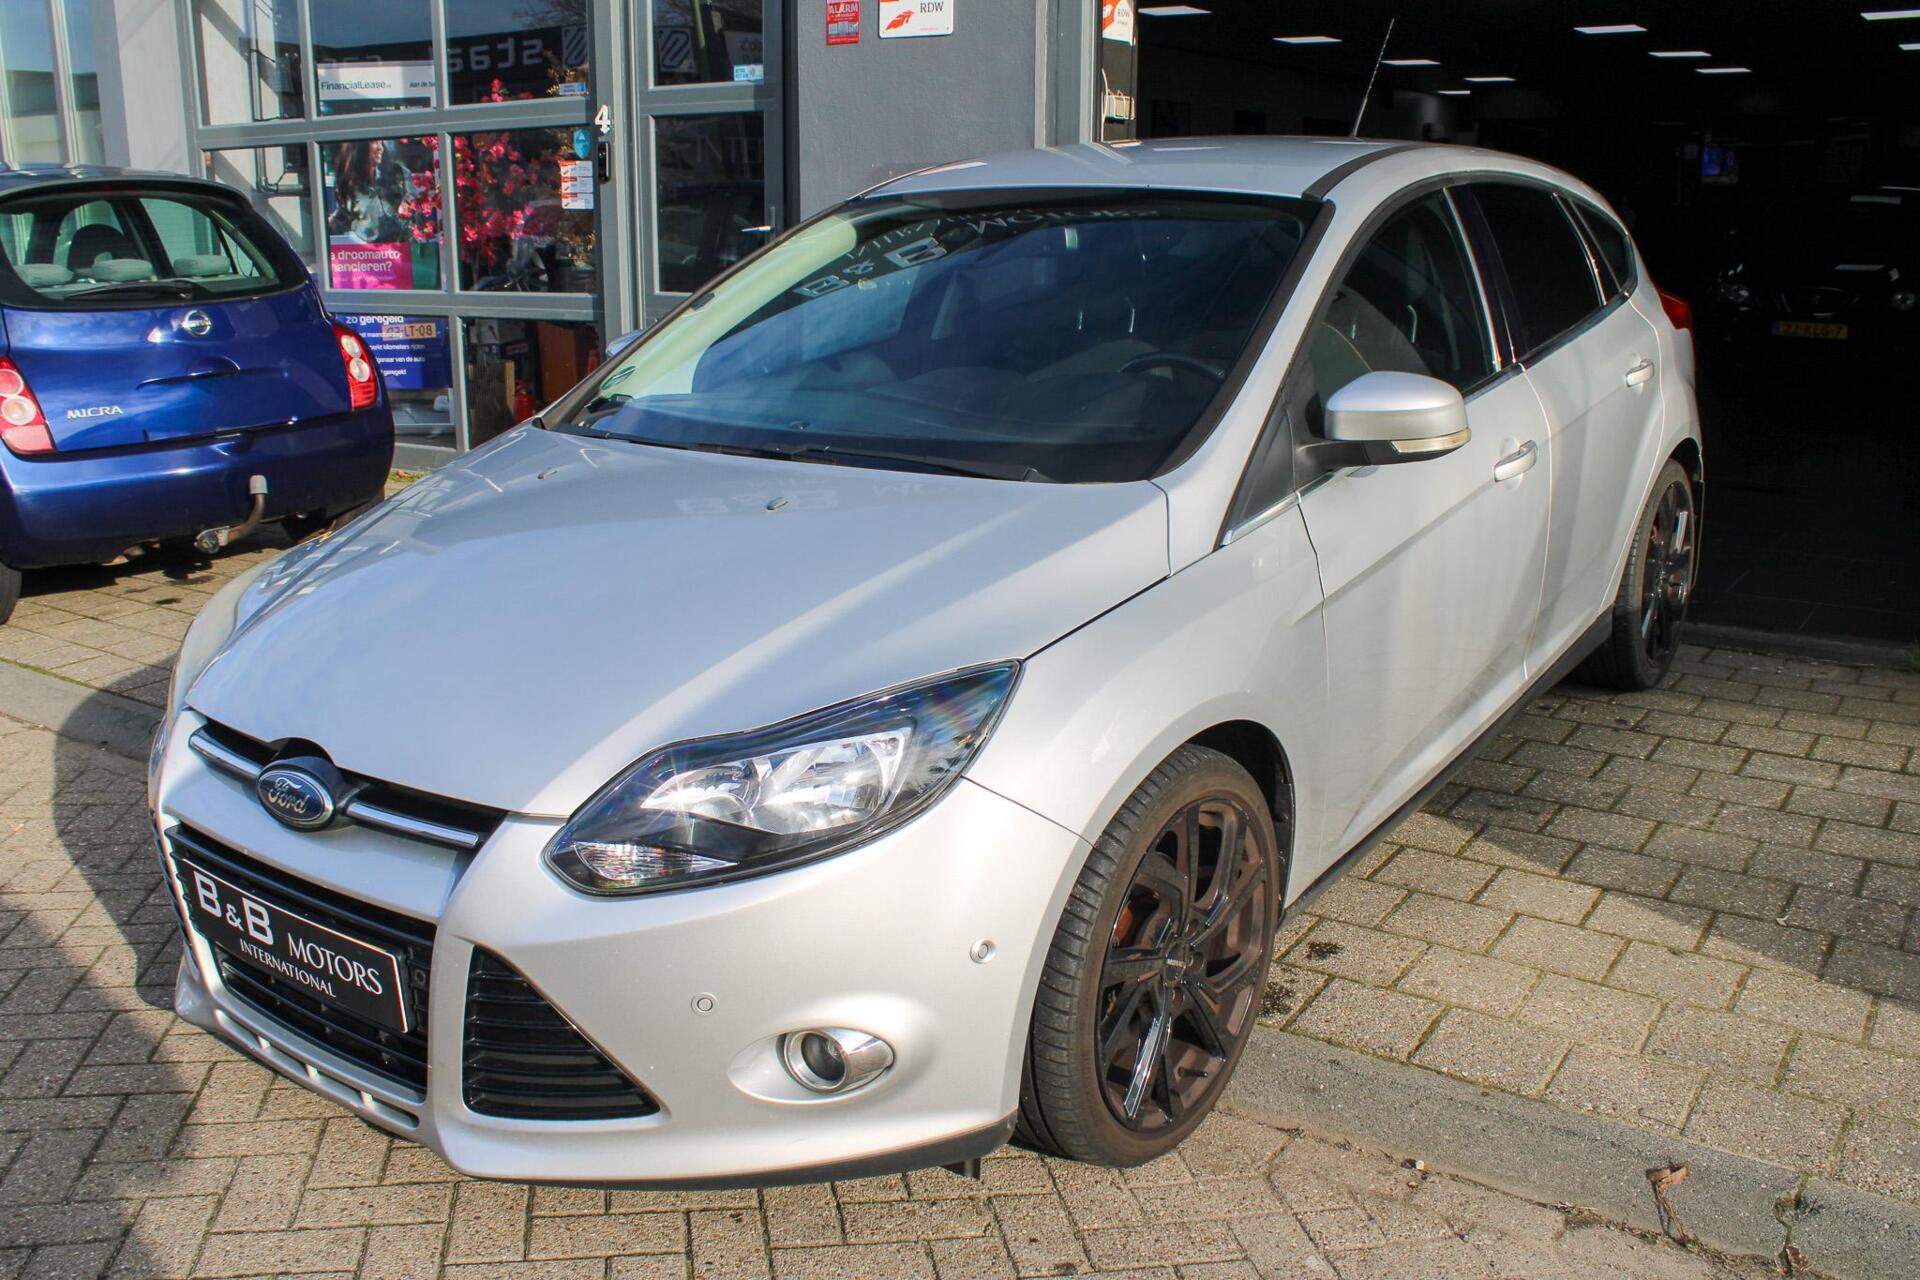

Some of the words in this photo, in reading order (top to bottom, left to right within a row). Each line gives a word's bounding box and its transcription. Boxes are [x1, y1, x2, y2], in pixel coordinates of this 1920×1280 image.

[829, 2, 859, 13] ALARM
[920, 2, 944, 13] RDW
[594, 104, 611, 134] 4
[337, 249, 401, 260] droomauto
[346, 316, 358, 324] zo
[66, 404, 124, 420] MICRA
[268, 776, 310, 814] Ford
[239, 938, 337, 998] INTERNATIONAL
[287, 932, 384, 996] MOTORS
